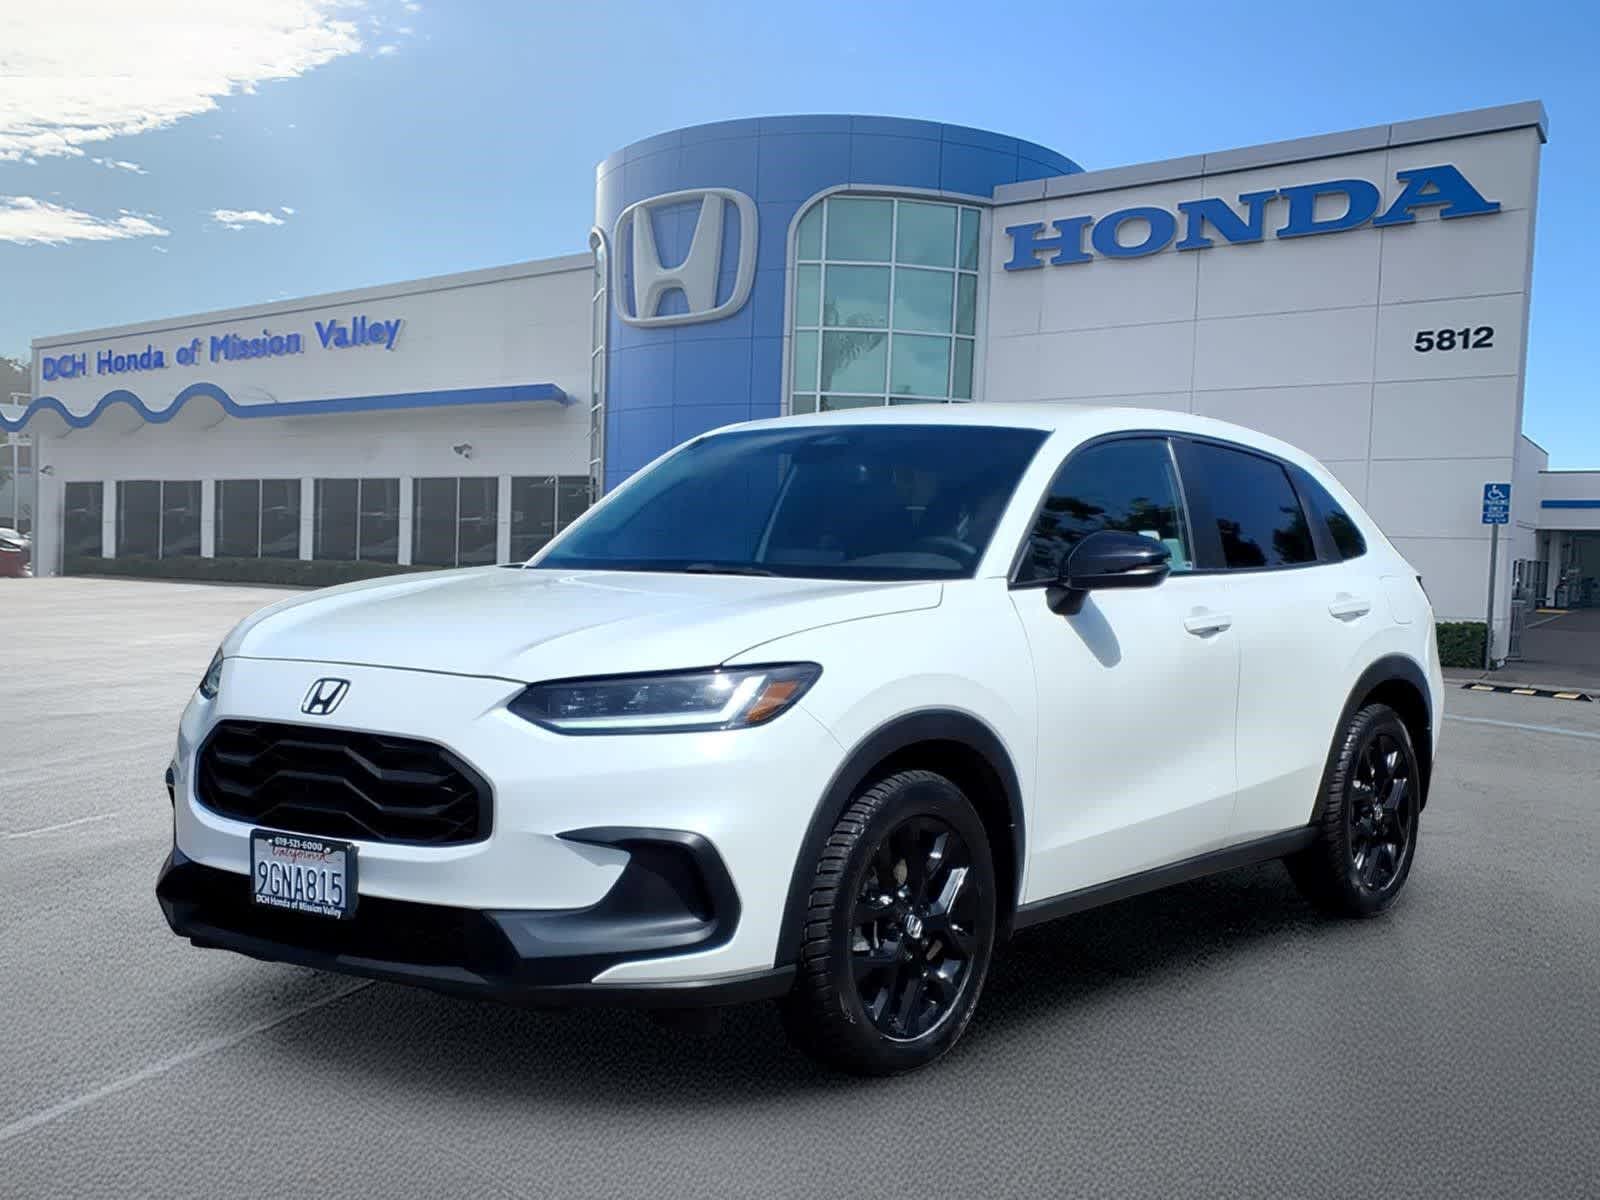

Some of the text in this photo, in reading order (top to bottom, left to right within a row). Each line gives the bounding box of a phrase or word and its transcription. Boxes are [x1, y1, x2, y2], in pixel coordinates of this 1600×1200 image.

[1004, 164, 1501, 272] HONDA
[43, 315, 402, 382] DCH Honda of Mission Valley
[1414, 326, 1494, 353] 5812
[274, 837, 323, 851] 619-521-6000
[258, 860, 343, 906] 9GNA815
